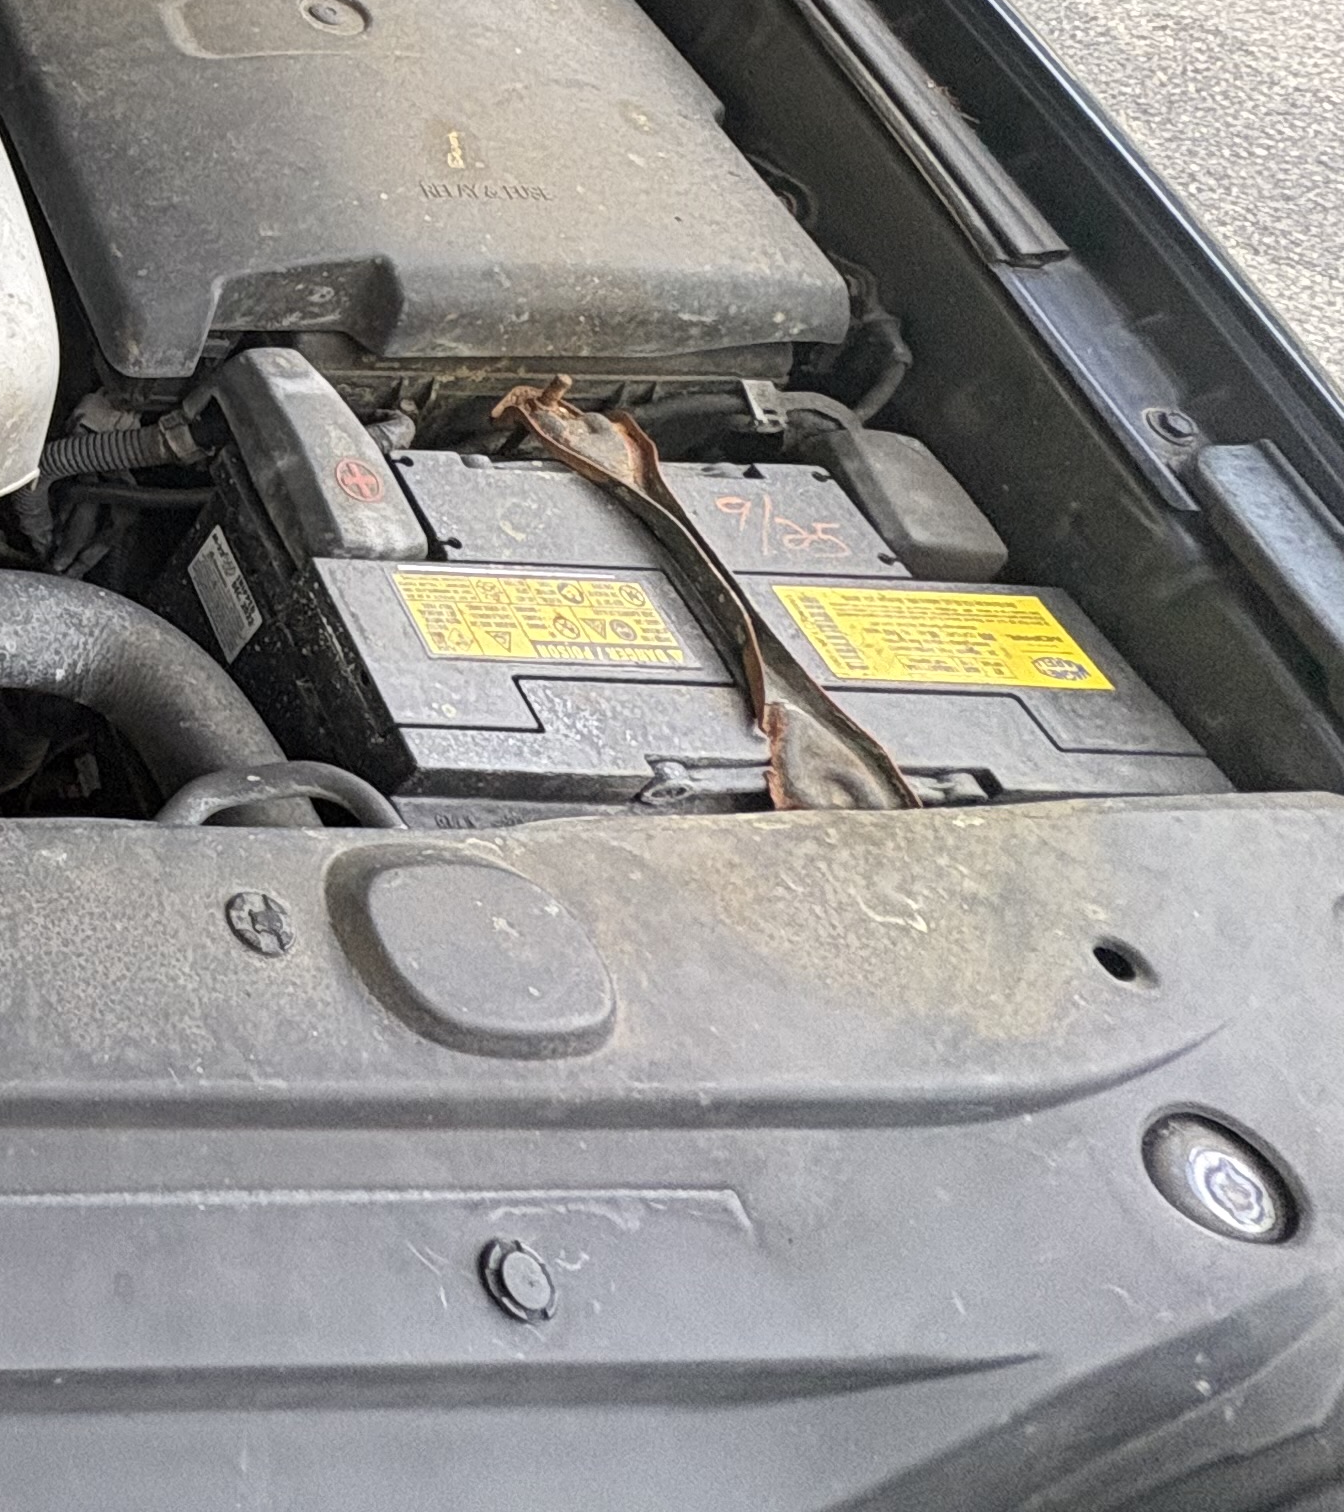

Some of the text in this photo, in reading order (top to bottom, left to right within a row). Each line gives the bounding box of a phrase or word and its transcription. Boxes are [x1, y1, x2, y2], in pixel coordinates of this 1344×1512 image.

[716, 492, 851, 559] 9/25
[537, 644, 595, 660] POISON
[606, 647, 669, 663] DANGER
